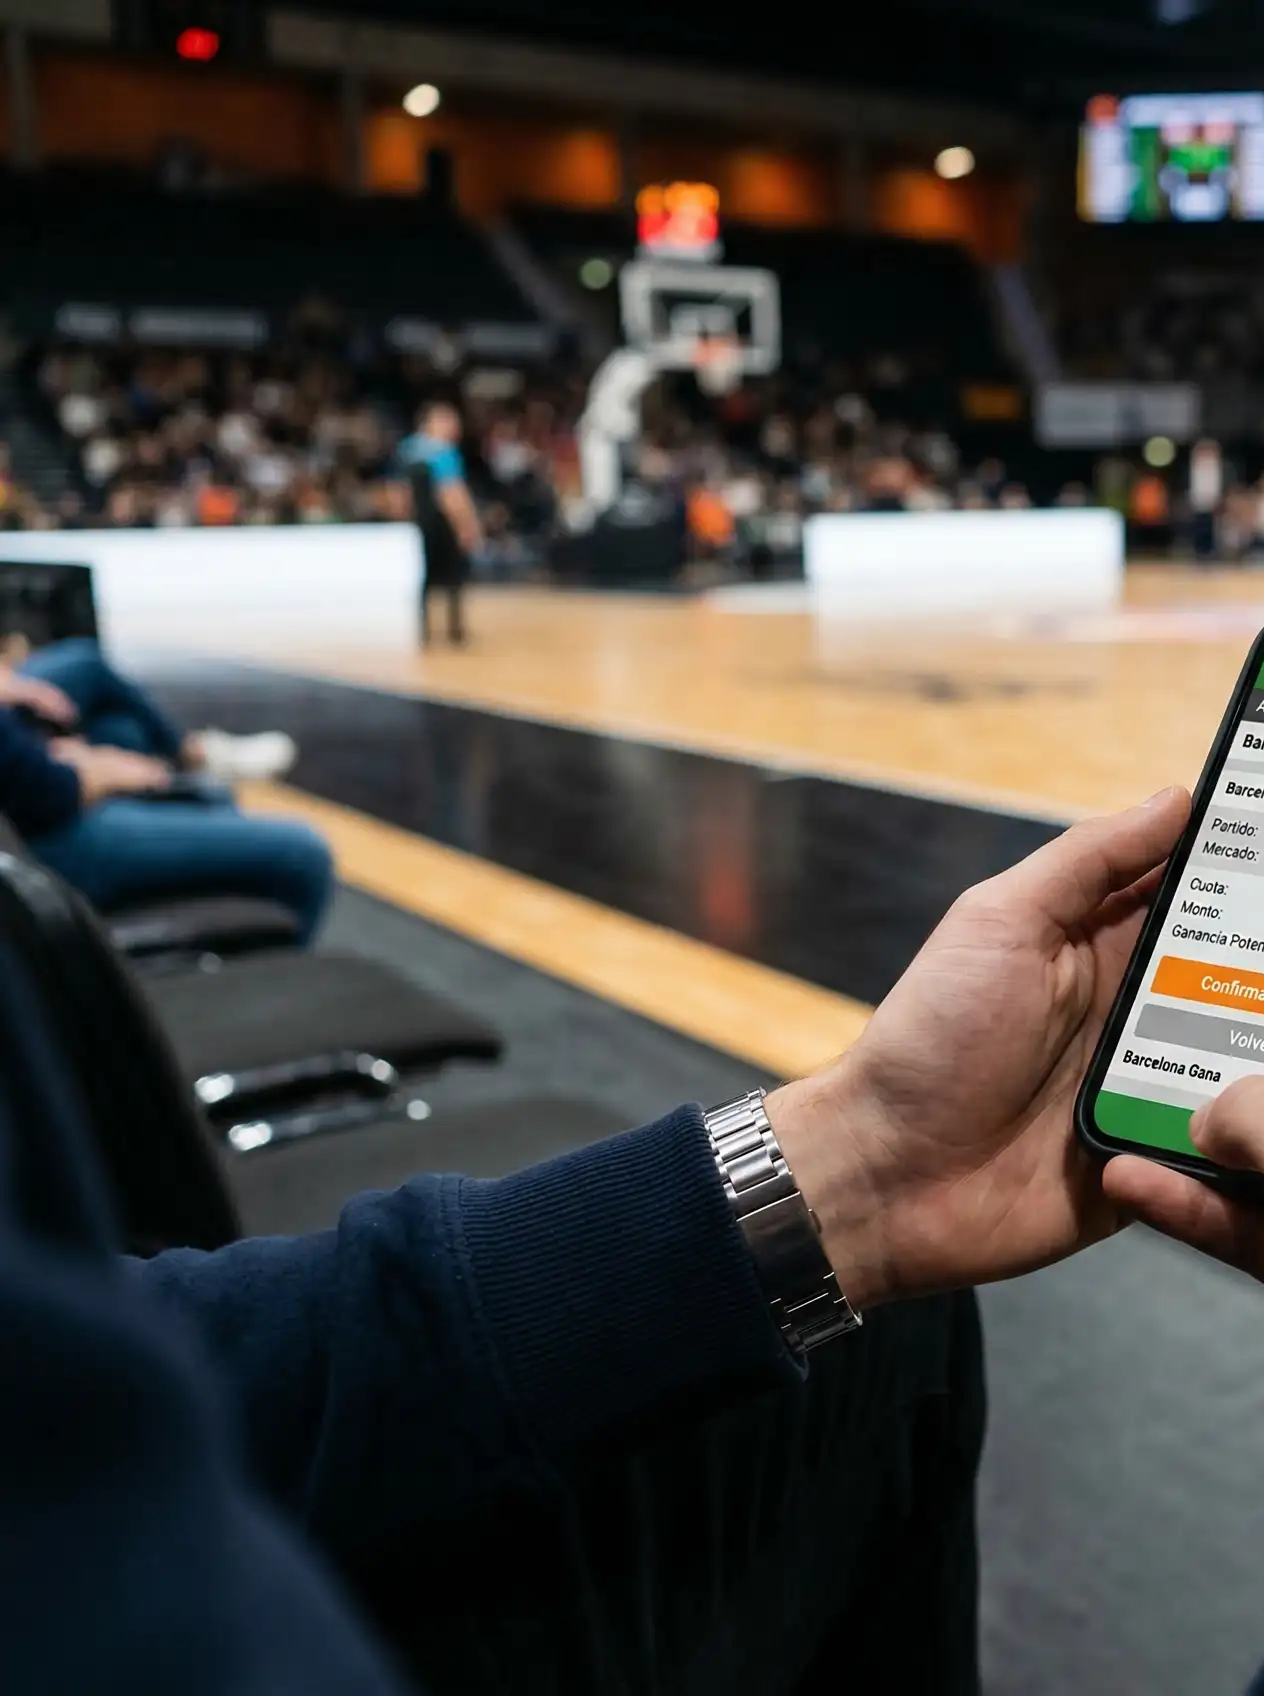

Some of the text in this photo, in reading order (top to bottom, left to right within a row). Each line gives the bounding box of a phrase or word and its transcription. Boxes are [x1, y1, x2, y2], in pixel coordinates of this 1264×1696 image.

[1203, 841, 1259, 862] Mercado:
[1190, 878, 1228, 896] Cuota:
[1180, 901, 1222, 920] Monto:
[1172, 924, 1228, 947] Ganancia
[1123, 1050, 1221, 1083] Barcelona Gana
